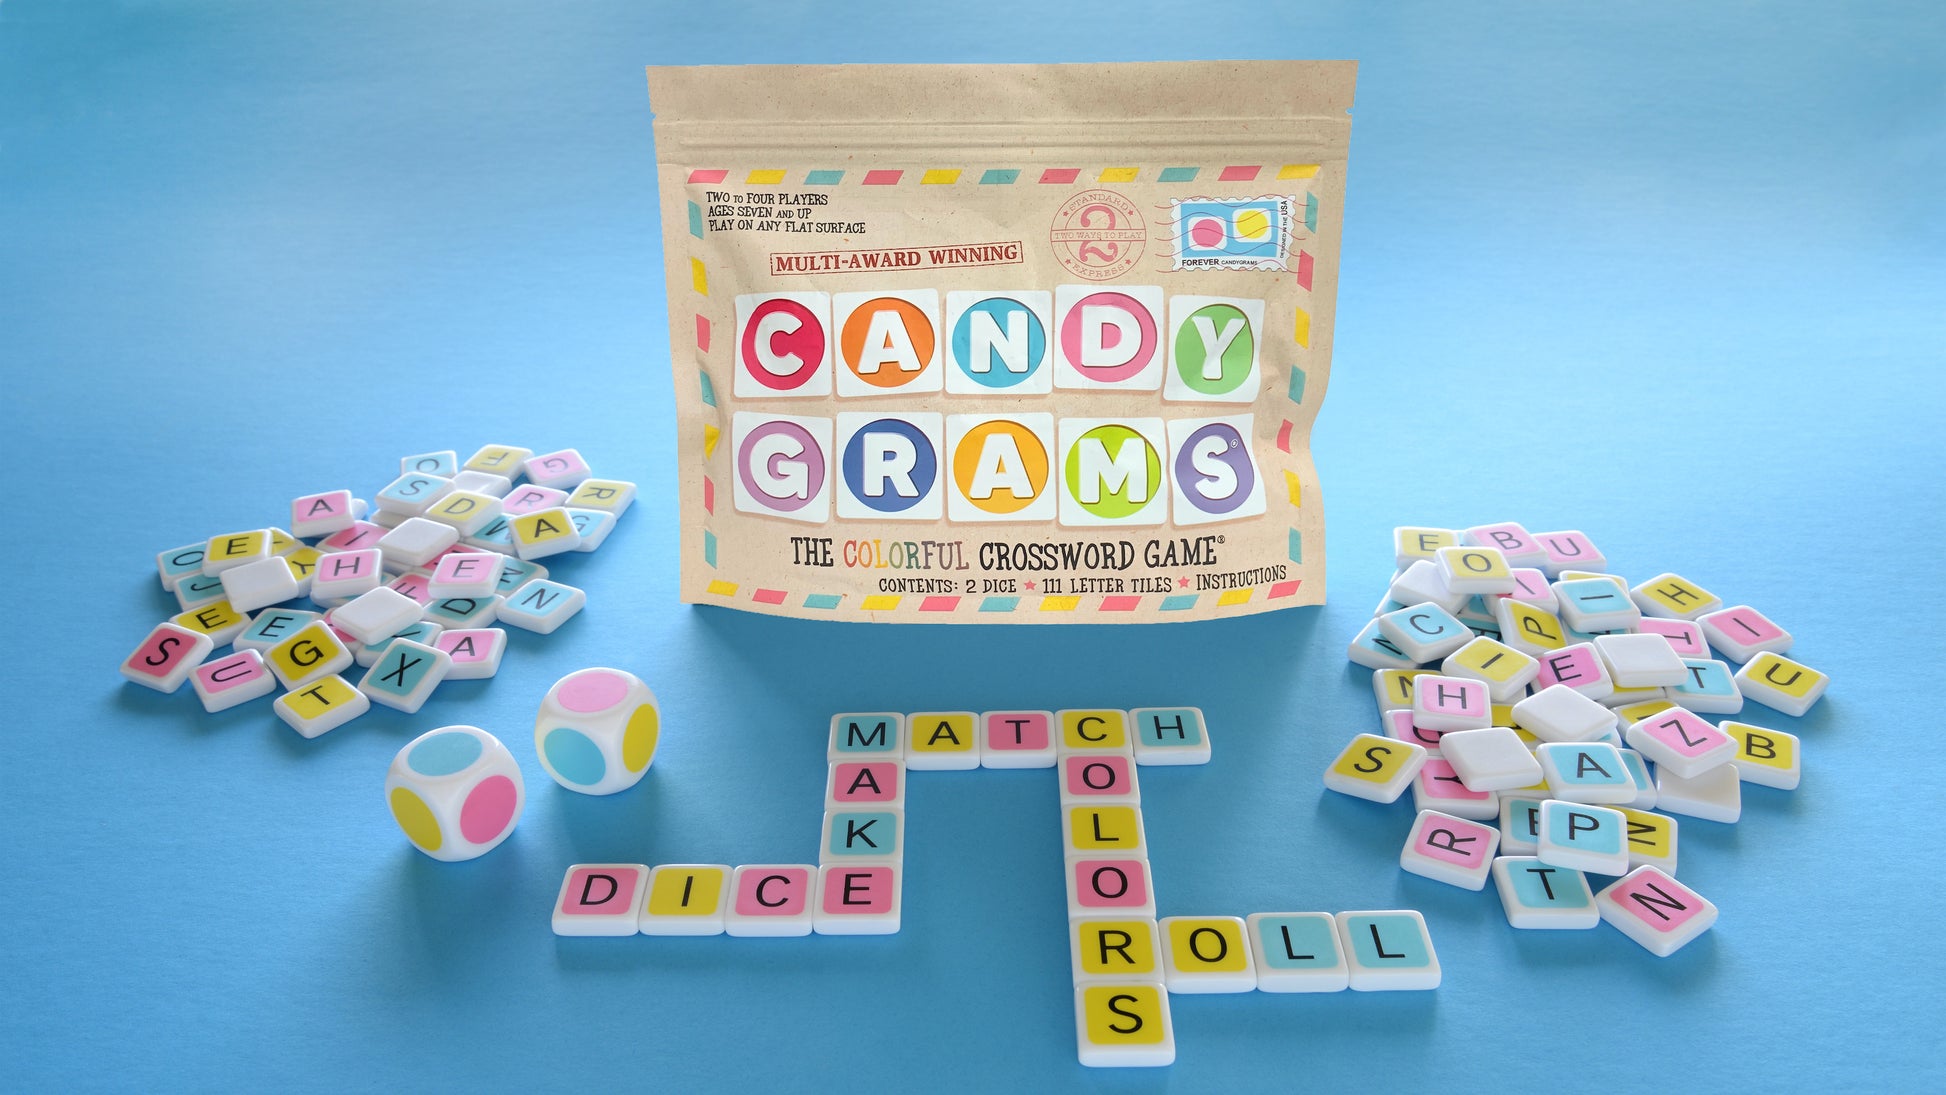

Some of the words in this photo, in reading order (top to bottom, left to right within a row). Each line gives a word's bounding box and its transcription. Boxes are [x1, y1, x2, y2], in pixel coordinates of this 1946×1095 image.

[706, 191, 730, 203] TWO
[746, 192, 775, 204] FOUR
[778, 193, 828, 206] PLAYERS
[1069, 193, 1129, 212] STANDARD
[1280, 200, 1288, 216] USA
[708, 205, 734, 217] AGES
[737, 206, 773, 218] SEVEN
[797, 208, 812, 219] UP
[708, 219, 735, 231] PLAY
[737, 219, 753, 231] ON
[756, 221, 781, 231] ANY
[785, 221, 813, 233] FLAT
[815, 222, 866, 234] SURFACE
[1055, 232, 1074, 240] TWO
[1076, 231, 1102, 239] WAYS
[1104, 231, 1116, 239] TO
[1118, 231, 1142, 239] PLAY
[776, 251, 922, 272] MULTI-AWARD
[928, 244, 1018, 264] WINNING
[1072, 263, 1125, 278] EXPRESS
[754, 305, 1246, 380] CANDY
[399, 480, 429, 496] S
[308, 499, 334, 516] A
[443, 497, 476, 515] D
[514, 492, 544, 508] R
[533, 518, 560, 538] A
[226, 537, 250, 556] E
[1418, 533, 1440, 552] E
[1489, 531, 1523, 550] B
[1549, 537, 1582, 557] U
[791, 537, 834, 567] THE
[843, 539, 970, 571] COLORFUL
[979, 541, 1135, 571] CROSSWORD
[1462, 553, 1492, 573] O
[334, 557, 360, 577] H
[452, 559, 480, 578] E
[879, 578, 959, 593] CONTENTS:
[966, 579, 977, 594] 2
[983, 579, 1017, 593] DICE
[1042, 578, 1063, 594] 111
[1070, 578, 1124, 594] LETTER
[1131, 577, 1172, 593] TILES
[1196, 565, 1287, 591] INSTRUCTIONS
[439, 598, 477, 615] D
[520, 587, 560, 610] N
[196, 608, 228, 630] E
[258, 617, 294, 638] E
[1409, 614, 1444, 636] C
[1523, 616, 1557, 641] P
[145, 637, 180, 667] S
[289, 640, 325, 667] G
[449, 636, 476, 657] A
[380, 652, 423, 687] X
[1549, 654, 1582, 683] E
[1765, 662, 1803, 686] U
[300, 685, 331, 706] T
[1438, 684, 1468, 710] H
[846, 715, 1185, 748] MATCH
[1746, 732, 1777, 760] B
[1354, 747, 1392, 773] S
[1576, 752, 1612, 779] A
[1568, 812, 1600, 841] P
[1426, 828, 1477, 857] R
[579, 873, 873, 908] DICE
[1526, 868, 1556, 900] T
[1098, 924, 1406, 965] ROLL
